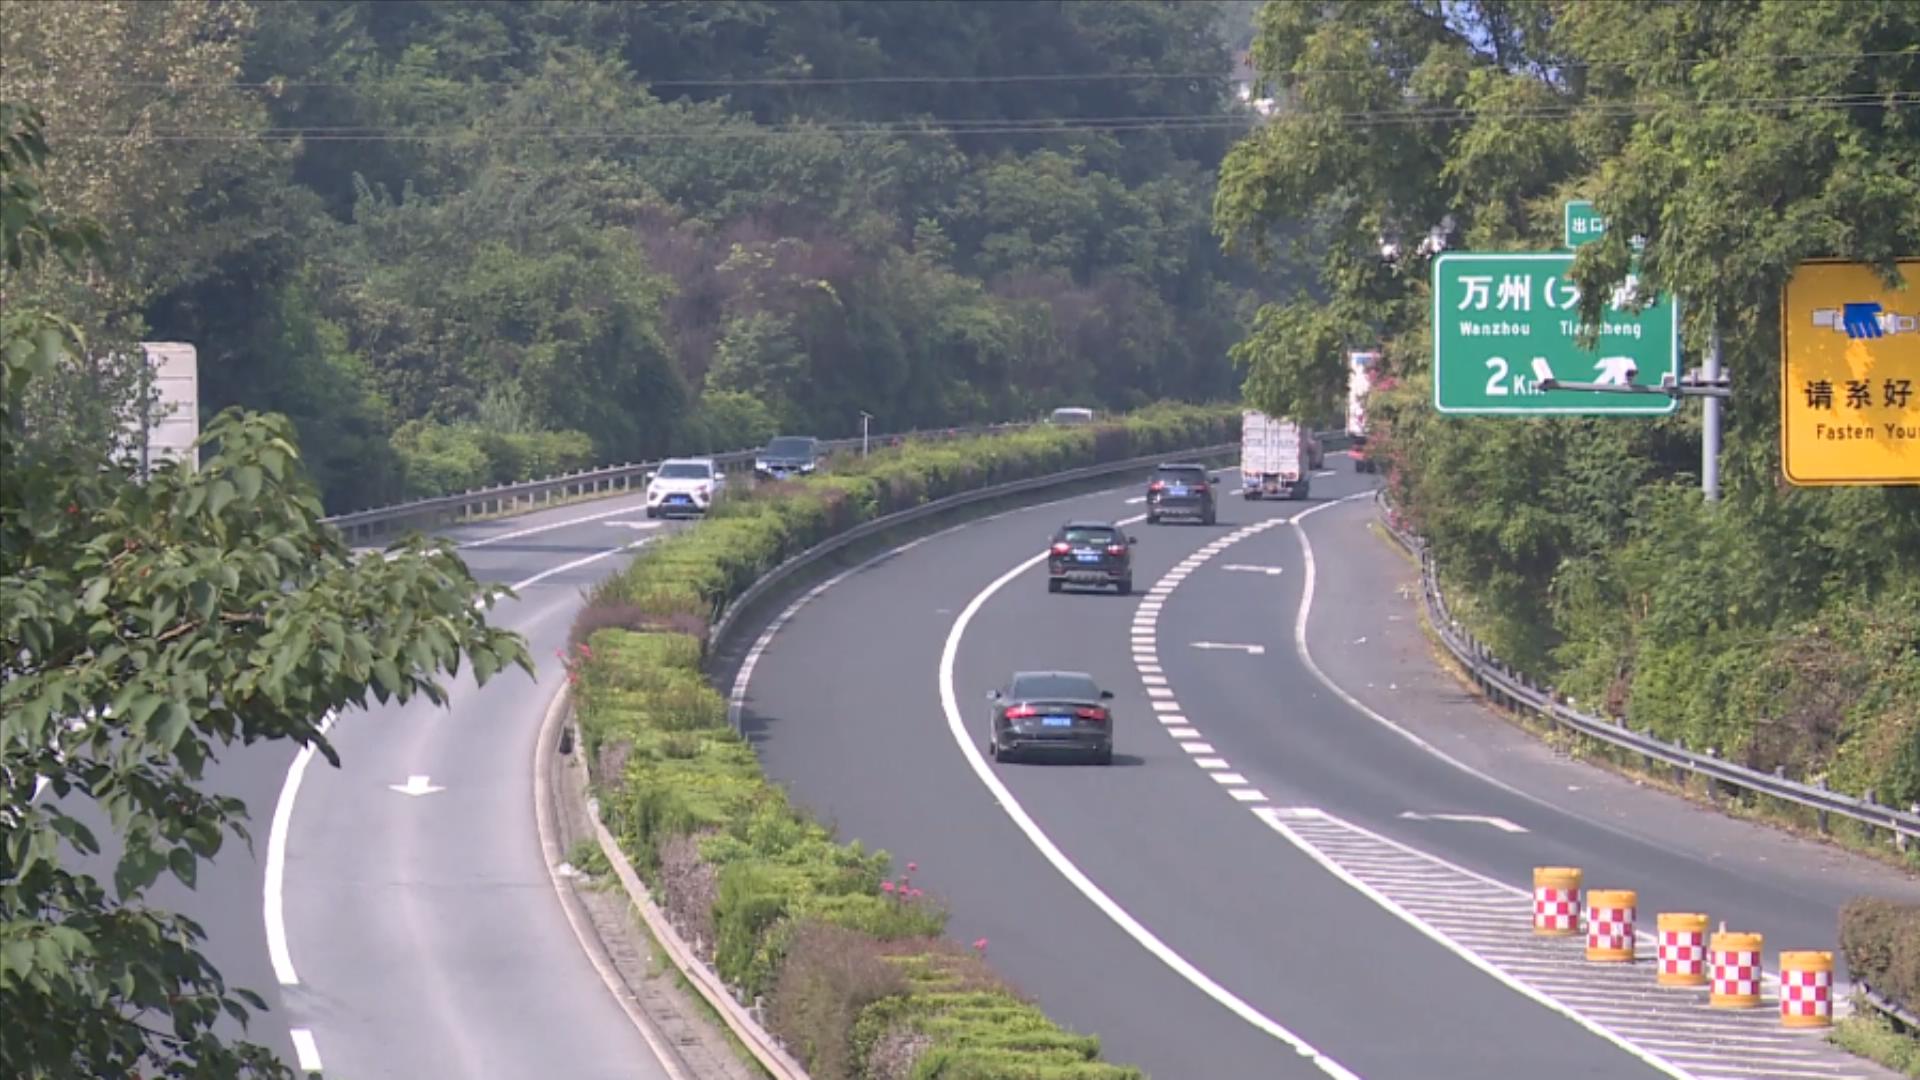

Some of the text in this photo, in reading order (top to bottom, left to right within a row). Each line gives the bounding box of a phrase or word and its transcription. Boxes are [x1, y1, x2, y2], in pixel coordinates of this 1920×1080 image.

[1572, 217, 1603, 234] 出口
[1458, 274, 1654, 311] 万州(
[1459, 320, 1530, 337] Wanzhou
[1485, 356, 1509, 396] 2
[1804, 379, 1913, 411] 请系好
[1816, 422, 1920, 440] Fasten You
